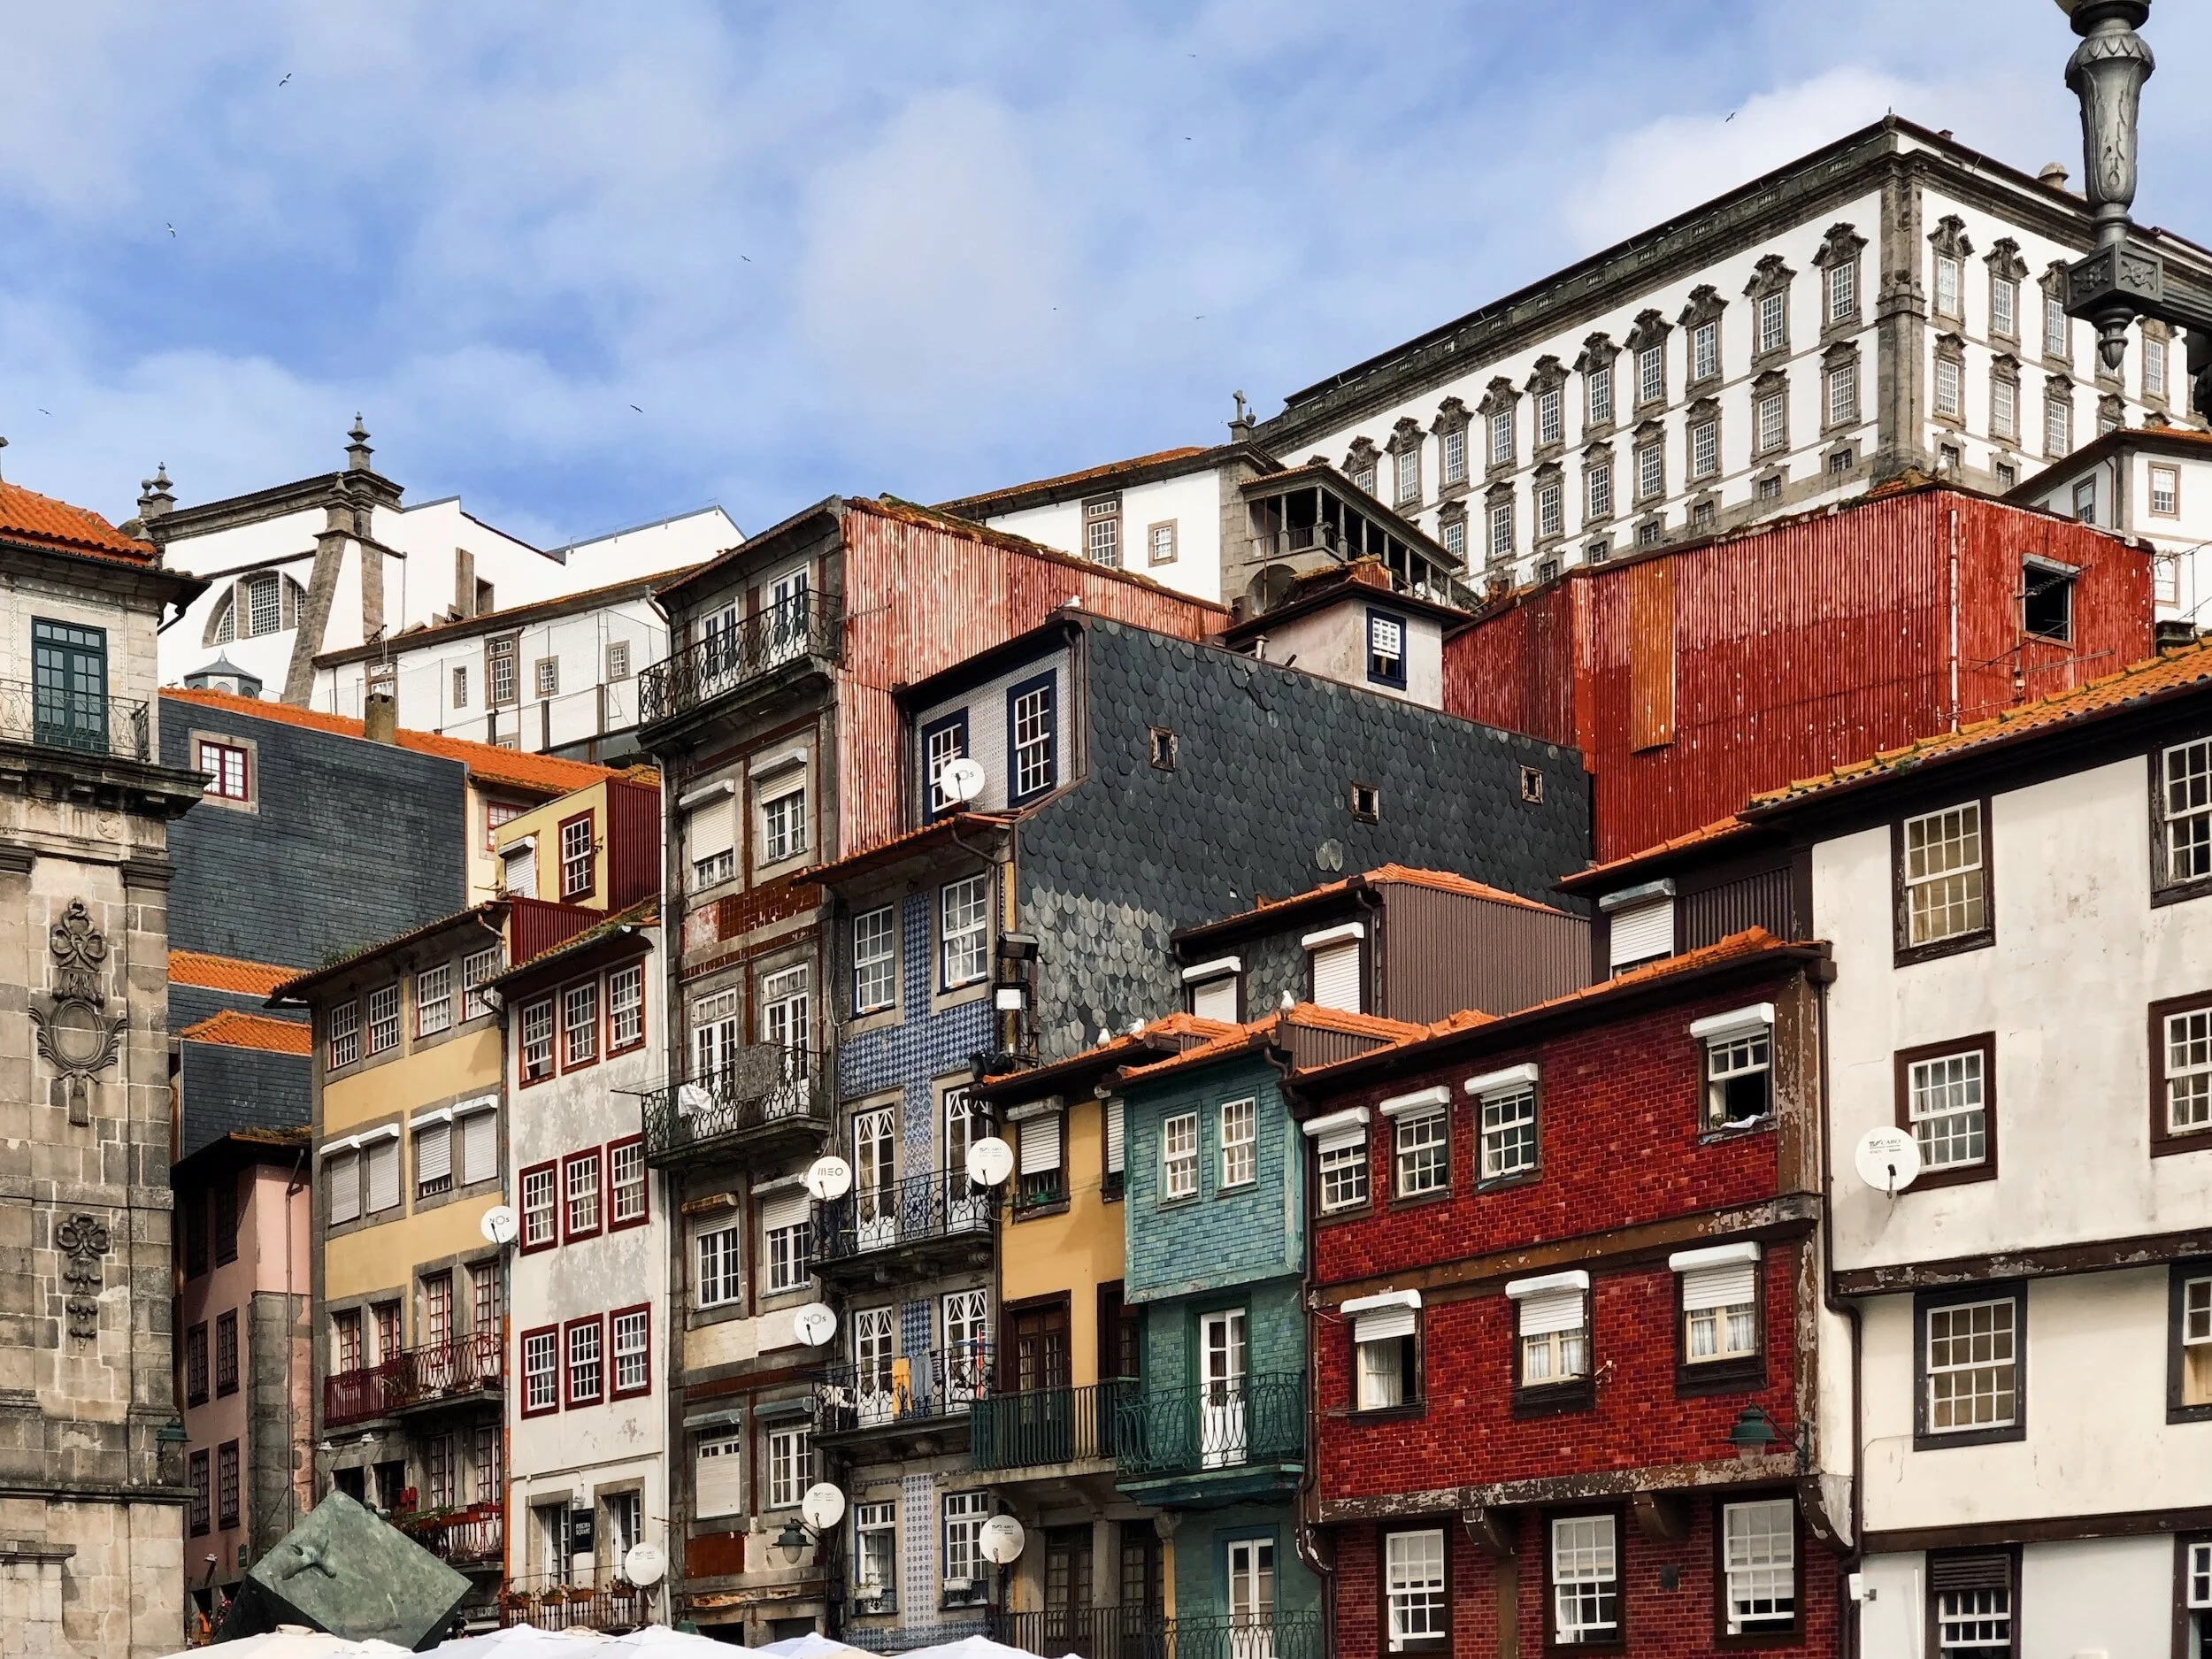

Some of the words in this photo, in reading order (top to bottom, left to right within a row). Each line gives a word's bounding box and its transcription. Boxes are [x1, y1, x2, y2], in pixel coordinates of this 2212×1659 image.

[818, 1167, 843, 1177] MEO
[489, 1215, 510, 1225] NOS
[804, 1313, 826, 1325] NOS
